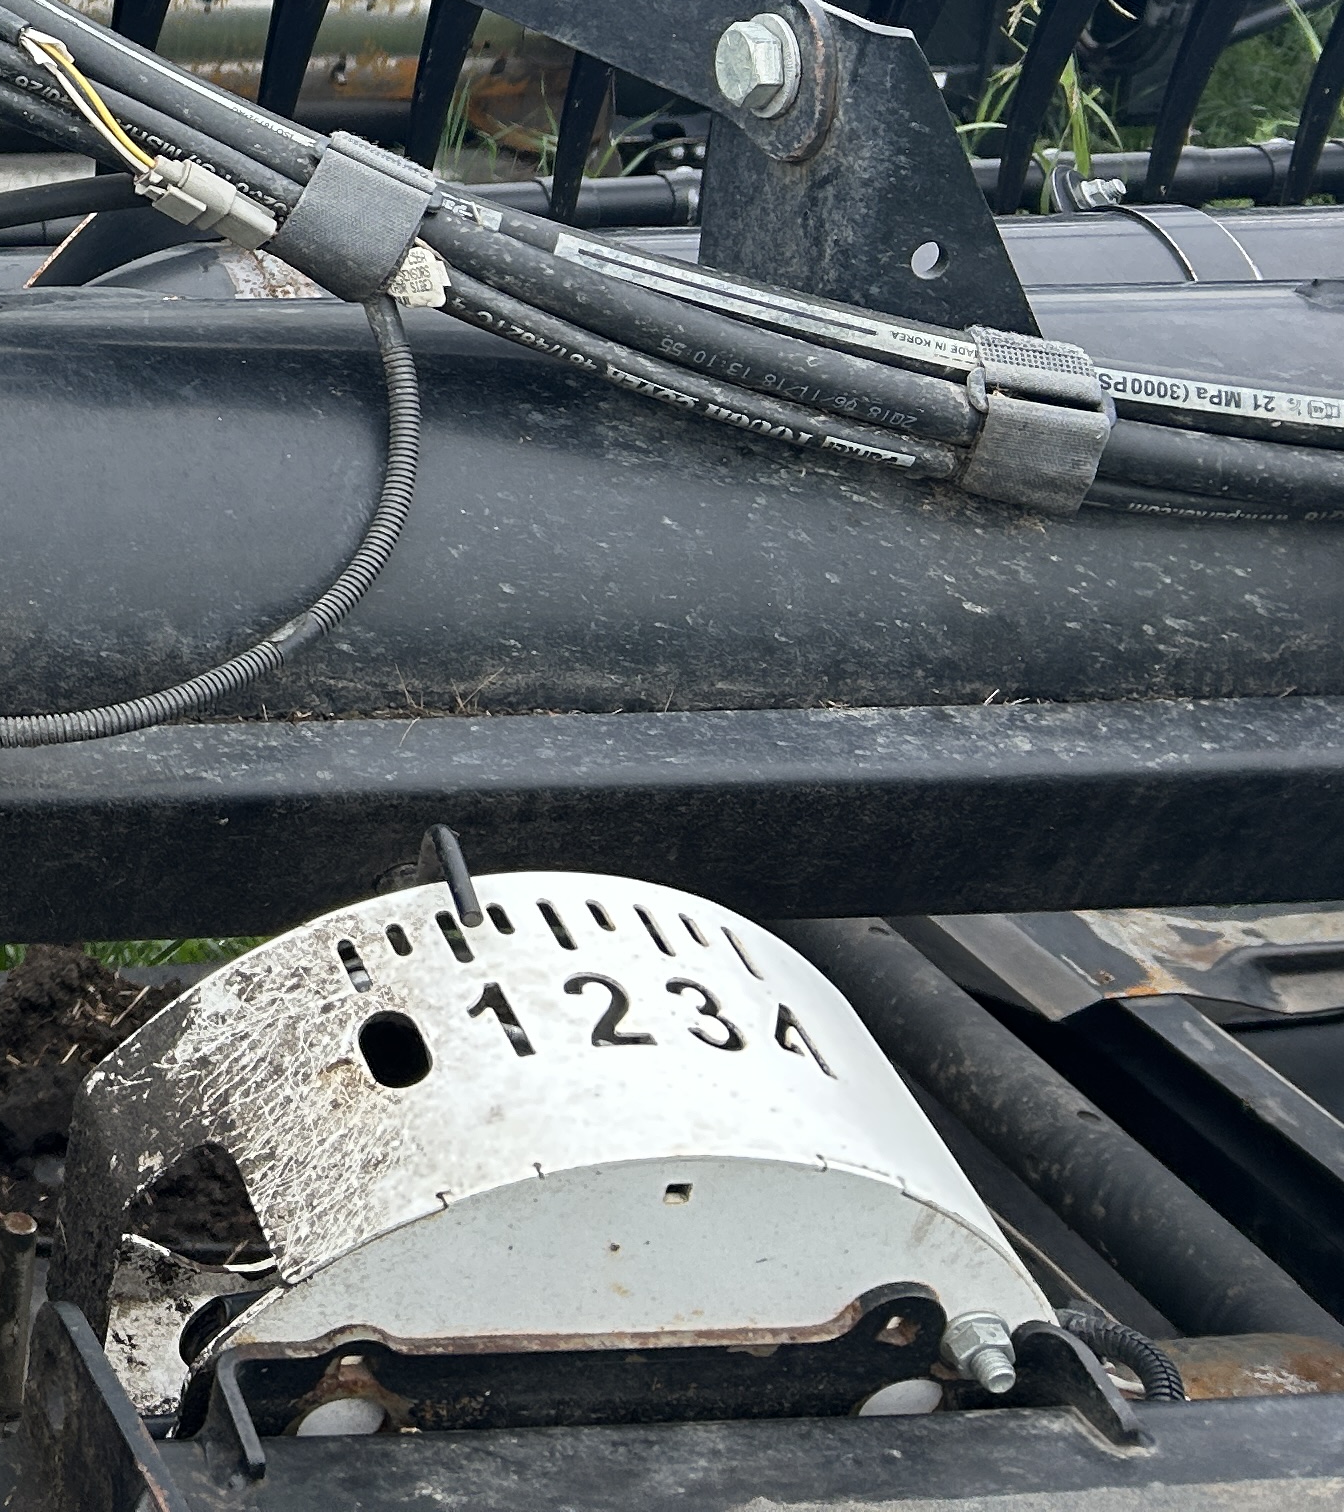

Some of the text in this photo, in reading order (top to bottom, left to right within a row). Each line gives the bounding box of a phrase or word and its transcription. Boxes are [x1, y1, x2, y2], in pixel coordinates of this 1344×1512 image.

[889, 328, 932, 348] KOREA
[932, 338, 947, 352] IN
[655, 334, 753, 380] 13:10:55
[1192, 385, 1244, 410] MPa
[1250, 393, 1277, 413] 21
[865, 403, 917, 431] 2018
[467, 982, 536, 1057] 1
[563, 971, 658, 1047] 2
[665, 976, 746, 1051] 3
